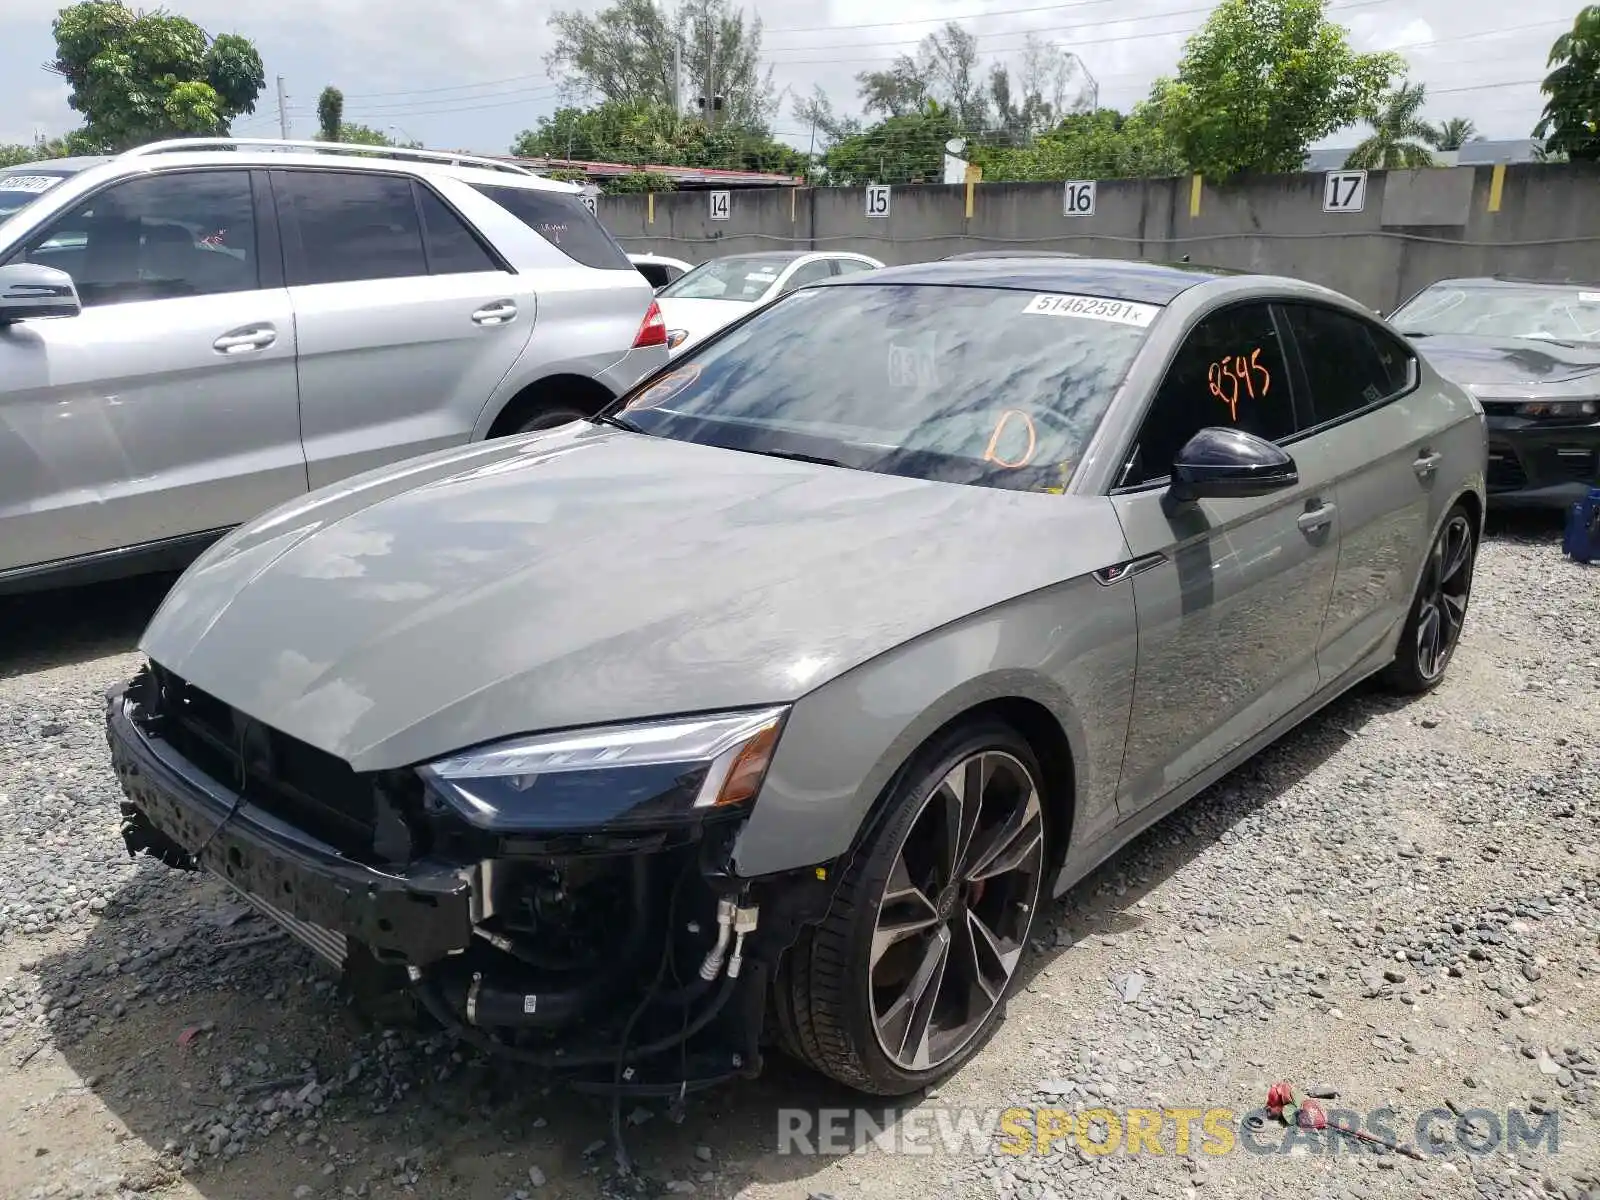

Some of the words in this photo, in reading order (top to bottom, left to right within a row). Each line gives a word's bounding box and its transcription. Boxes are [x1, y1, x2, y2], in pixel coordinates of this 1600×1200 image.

[869, 189, 887, 213] 15
[1068, 184, 1091, 212] 16
[1329, 176, 1362, 207] 17
[712, 195, 728, 217] 14
